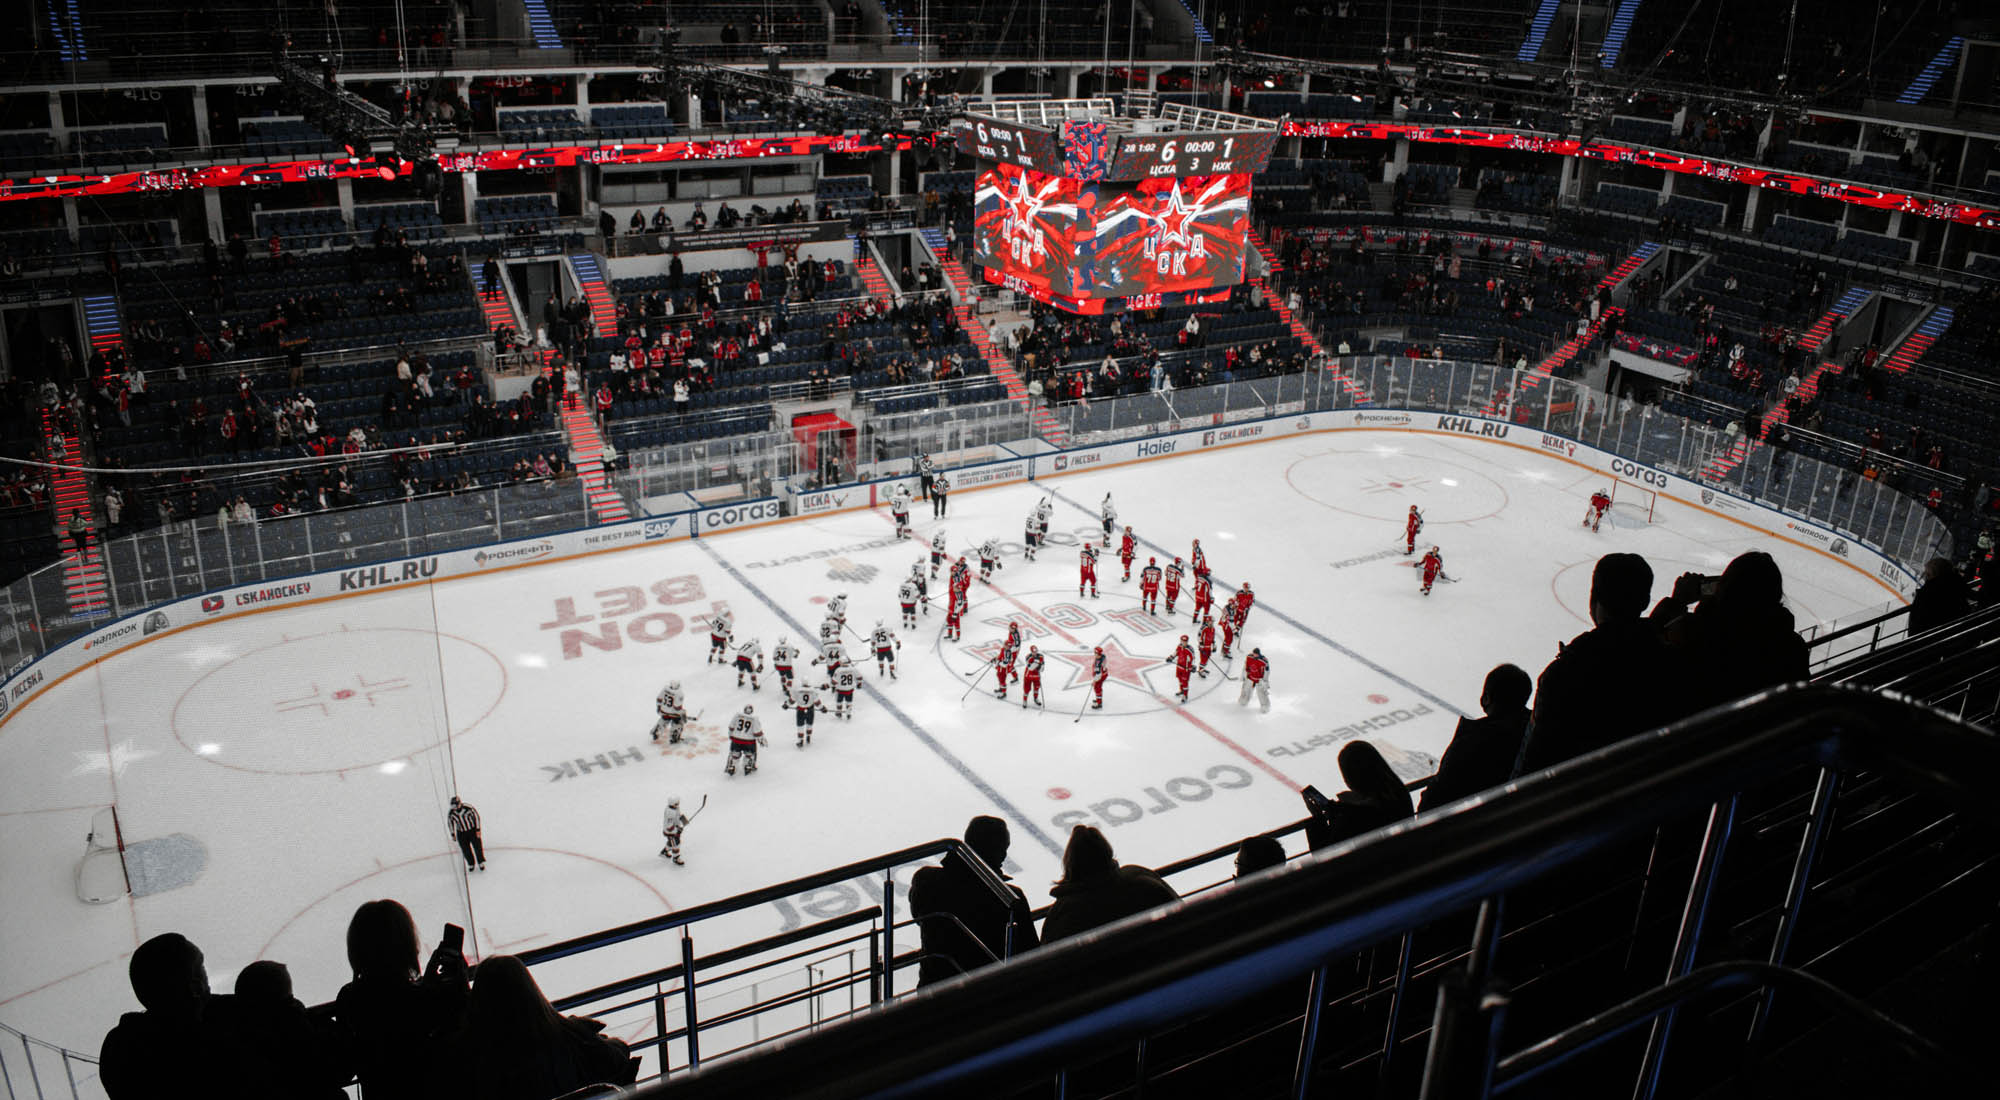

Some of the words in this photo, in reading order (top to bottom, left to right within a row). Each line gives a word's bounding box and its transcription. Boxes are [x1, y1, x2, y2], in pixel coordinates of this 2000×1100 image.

[976, 122, 989, 144] 6
[1015, 130, 1027, 153] 1
[1001, 145, 1009, 158] 3
[1138, 142, 1157, 153] 1:02
[1161, 140, 1177, 162] 6
[1184, 141, 1216, 153] 00:00
[1223, 137, 1235, 159] 1
[1149, 164, 1177, 177] ЦСКА
[1189, 157, 1200, 172] 3
[1211, 161, 1233, 172] НХК
[1142, 232, 1206, 276] ЦСКА
[1125, 292, 1163, 310] ЦСКА
[1437, 415, 1511, 439] KHL.RU
[1137, 439, 1177, 458] Haier
[1542, 434, 1566, 450] ЦСКА
[803, 492, 831, 508] ЦСКА
[645, 521, 671, 535] SAP
[487, 539, 554, 561] РОСНЕФТЬ
[339, 556, 439, 592] KHL.RU
[235, 581, 312, 607] CSKAHOCKEY
[539, 574, 707, 631] BET
[876, 632, 888, 643] 25
[841, 673, 854, 686] 28
[802, 694, 811, 705] 9
[738, 719, 752, 733] 39
[1265, 703, 1435, 758] РОСНЕФТЬ
